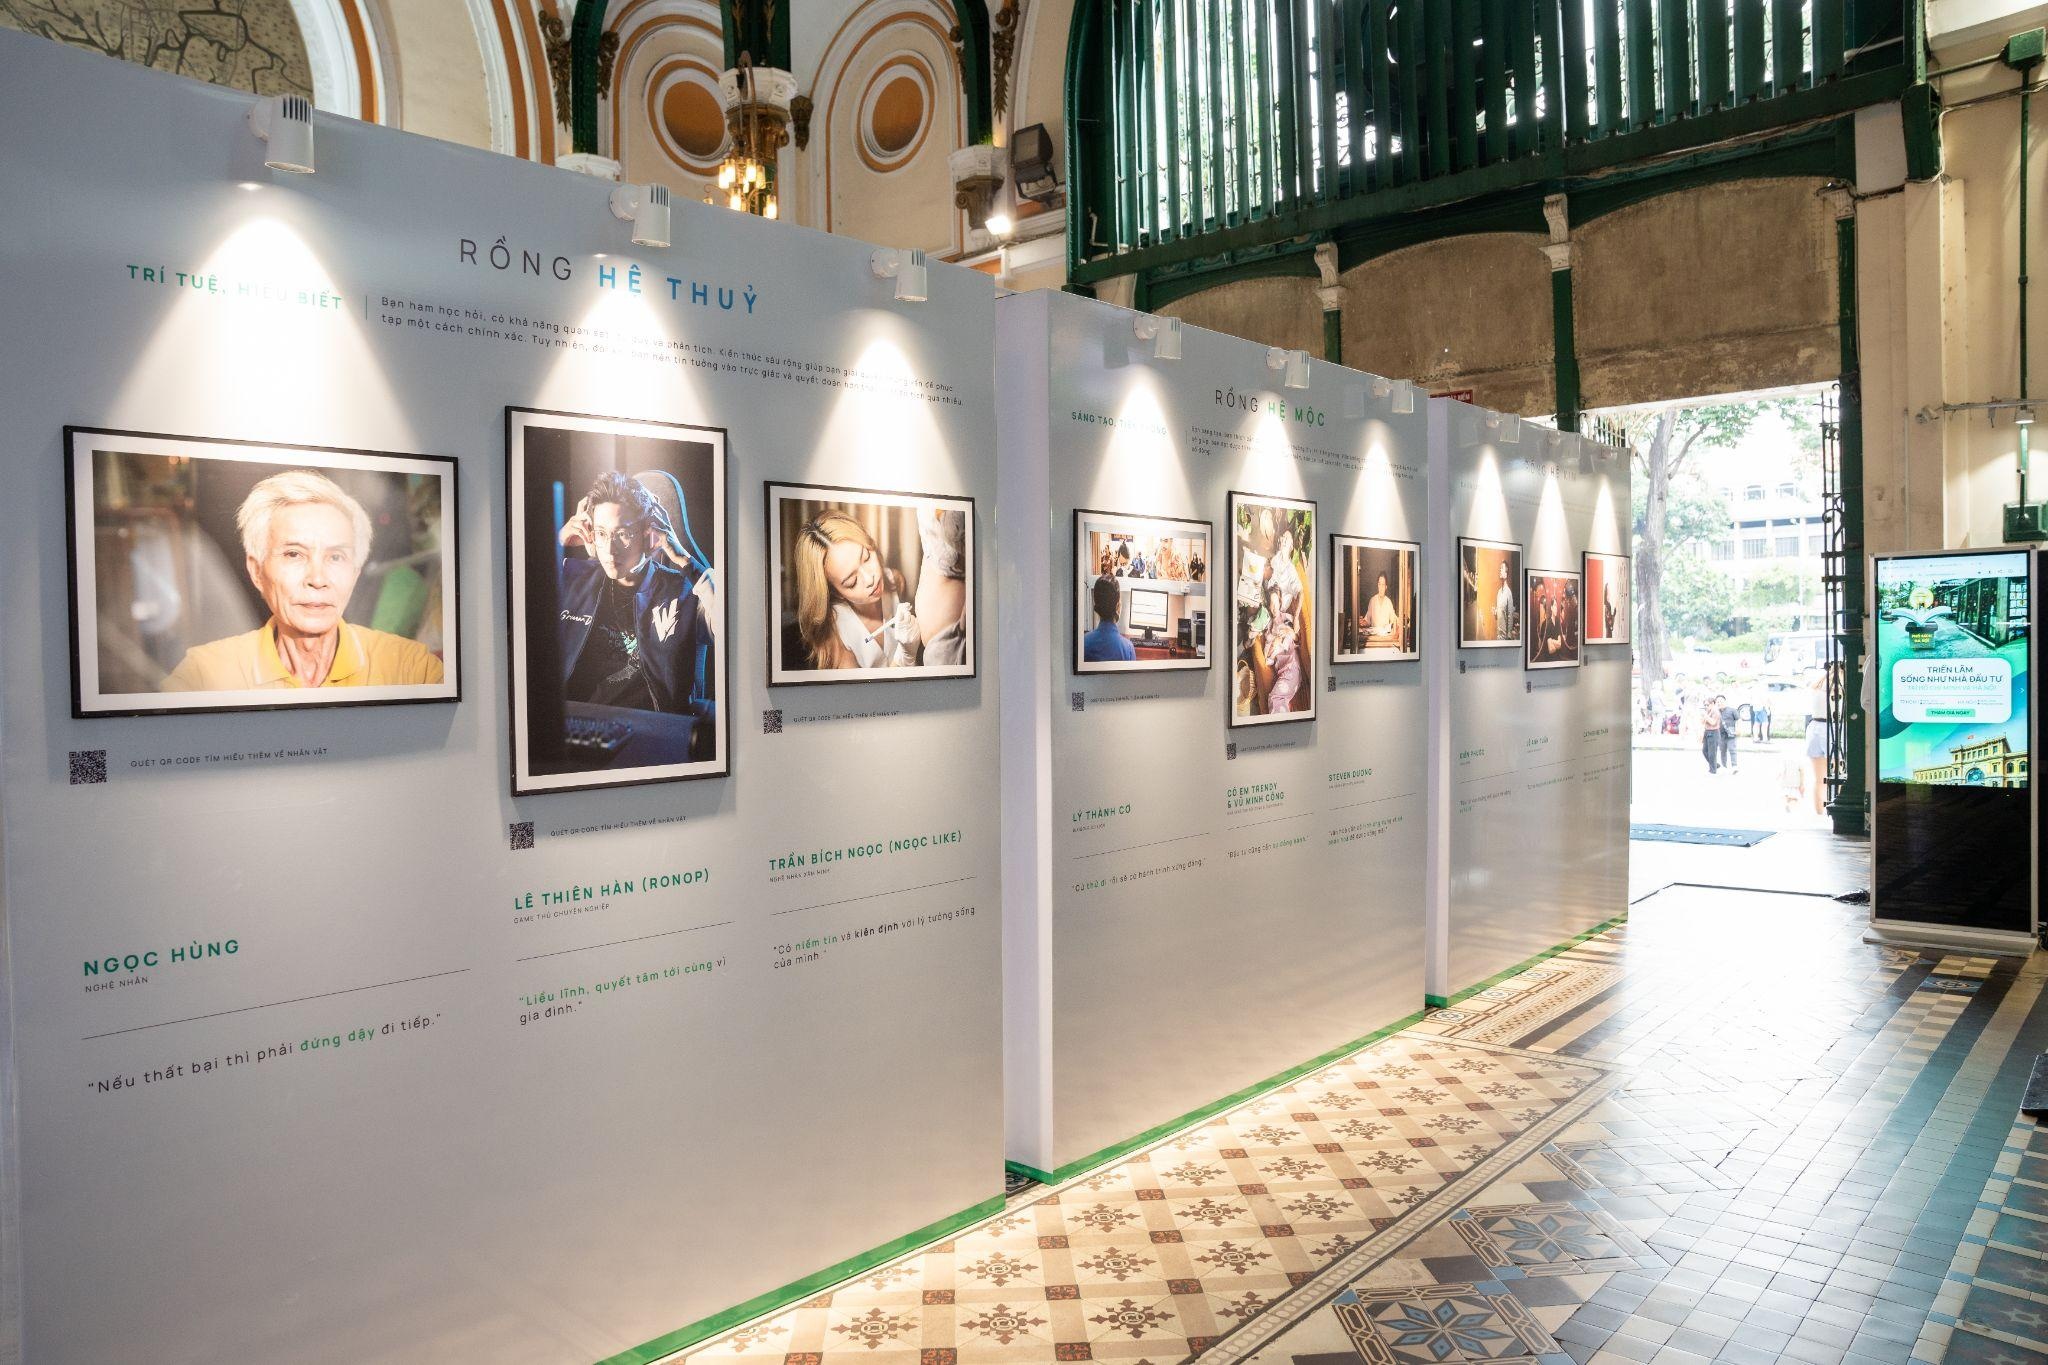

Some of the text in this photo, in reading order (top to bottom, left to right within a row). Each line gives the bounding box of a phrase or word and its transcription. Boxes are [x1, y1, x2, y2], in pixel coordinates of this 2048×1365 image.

[126, 265, 165, 283] TRÍ
[296, 288, 342, 309] BIẾT
[460, 235, 573, 281] RỒNG
[666, 277, 758, 314] THUỶ
[381, 296, 404, 309] Bạn
[409, 301, 434, 313] ham
[439, 306, 460, 319] học
[509, 315, 528, 327] khả
[532, 320, 559, 334] năng
[381, 314, 403, 327] tạp
[407, 317, 430, 330] một
[434, 320, 463, 334] cách
[468, 325, 500, 339] chính
[504, 330, 527, 343] xác.
[532, 334, 552, 348] Tuy
[674, 354, 687, 366] tin
[721, 362, 737, 373] vào
[1072, 410, 1095, 424] SÁNG
[1215, 386, 1259, 413] RỒNG
[1294, 405, 1326, 428] MỘC
[1900, 674, 1926, 683] SỐNG
[1928, 674, 1947, 683] NHƯ
[1948, 674, 1967, 683] NHÀ
[130, 756, 155, 768] QUÉT
[160, 756, 172, 767] QR
[176, 756, 201, 766] CODE
[204, 752, 220, 763] TÌM
[224, 750, 244, 762] HIỂU
[769, 830, 963, 871] TRẦN BÍCH NGỌC (NGỌC LIKE)
[515, 868, 710, 911] LÊ THIÊN HÀN (RONOP)
[513, 916, 534, 924] GAME
[795, 937, 820, 952] niềm
[823, 934, 838, 946] tin
[841, 931, 852, 942] và
[854, 924, 875, 939] kiên
[878, 920, 900, 936] định
[928, 910, 954, 925] tưởng
[956, 906, 976, 918] sống
[83, 939, 240, 978] NGỌC HÙNG
[560, 986, 590, 1000] lĩnh,
[595, 976, 631, 994] quyết
[636, 971, 660, 985] tâm
[664, 966, 681, 979] tới
[684, 960, 713, 975] cùng
[716, 956, 727, 968] vì
[774, 956, 792, 970] của
[119, 974, 149, 989] NHÂN
[519, 1012, 540, 1026] gia
[88, 1073, 136, 1094] "Nếu
[191, 1056, 219, 1075] bại
[226, 1049, 251, 1068] thì
[257, 1042, 294, 1063] phải
[299, 1034, 342, 1053] đứng
[347, 1026, 377, 1044] dậy
[381, 1020, 396, 1036] đi
[400, 1013, 443, 1033] tiếp."
